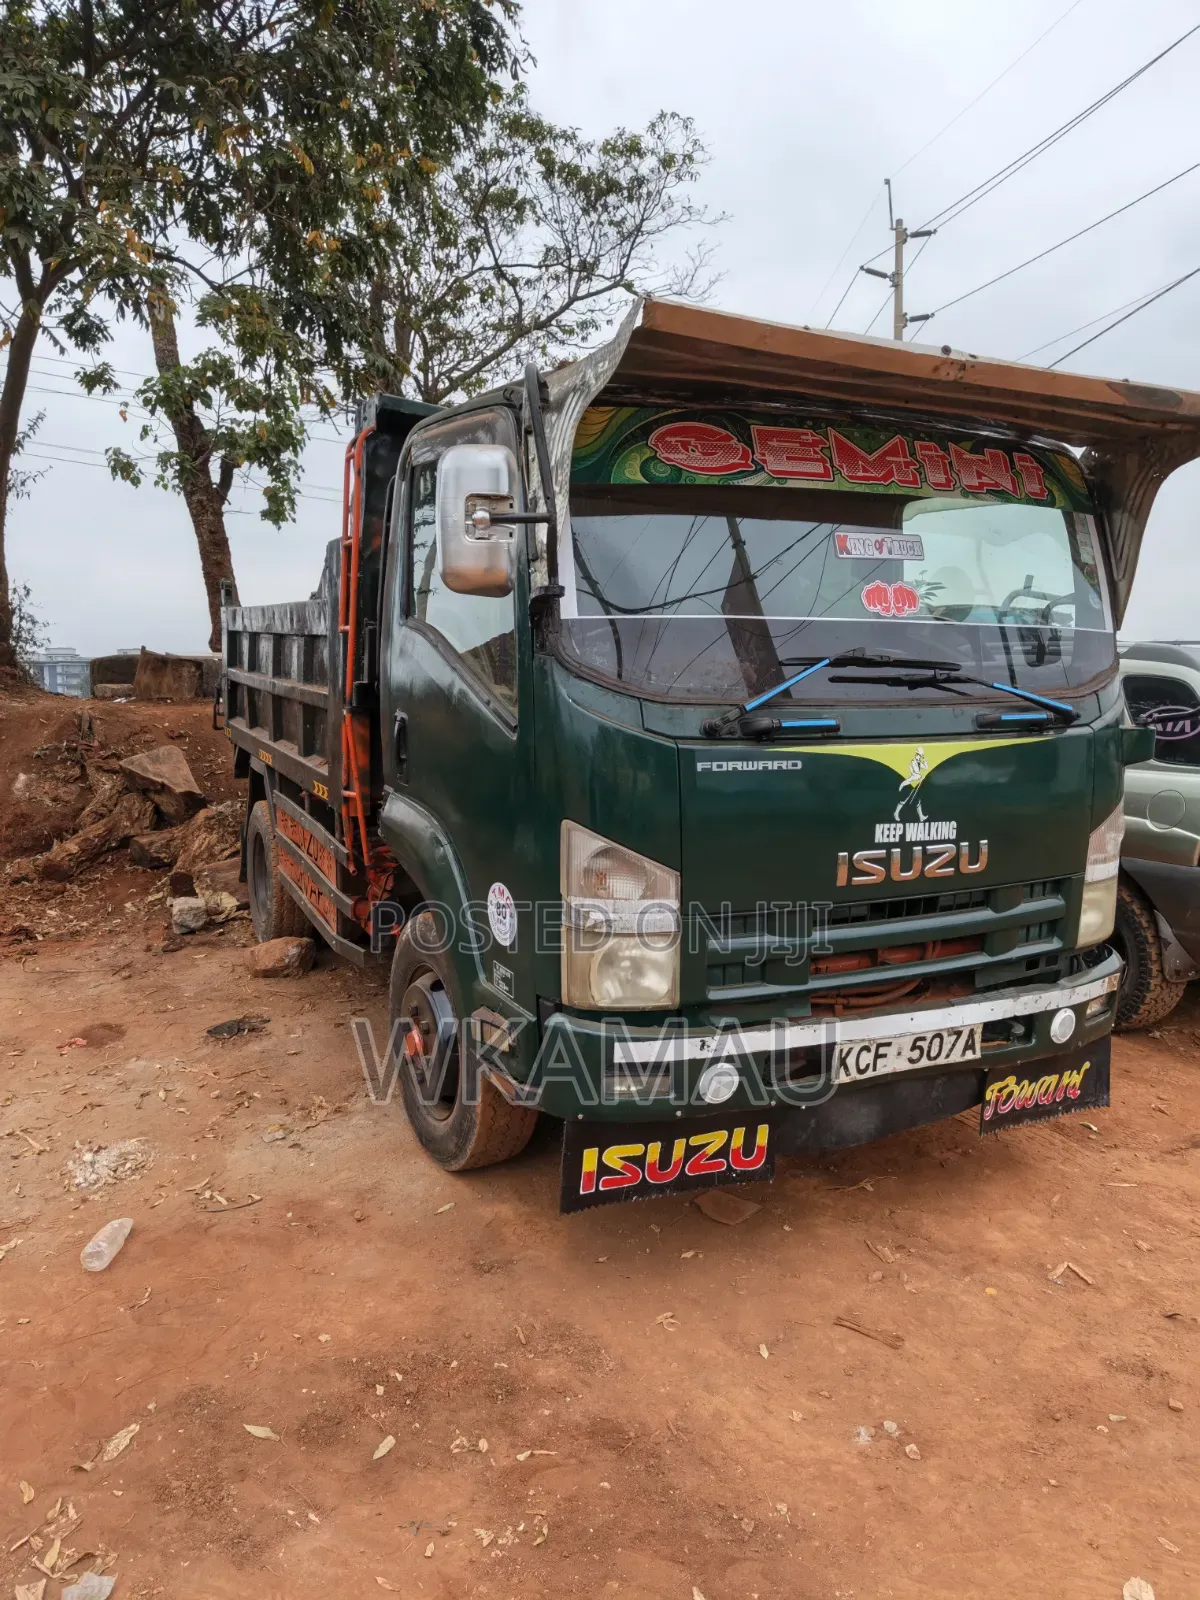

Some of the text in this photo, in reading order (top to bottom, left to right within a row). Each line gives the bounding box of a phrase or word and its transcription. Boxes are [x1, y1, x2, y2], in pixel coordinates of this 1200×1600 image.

[648, 421, 1049, 500] GEMINI
[836, 534, 874, 556] KING
[884, 536, 922, 557] TRUCK
[696, 760, 802, 772] FORWARD
[874, 821, 957, 843] KEEP WALKING
[836, 839, 988, 887] ISUZU
[838, 1027, 977, 1078] KCF 507A
[579, 1124, 769, 1195] ISUZU
